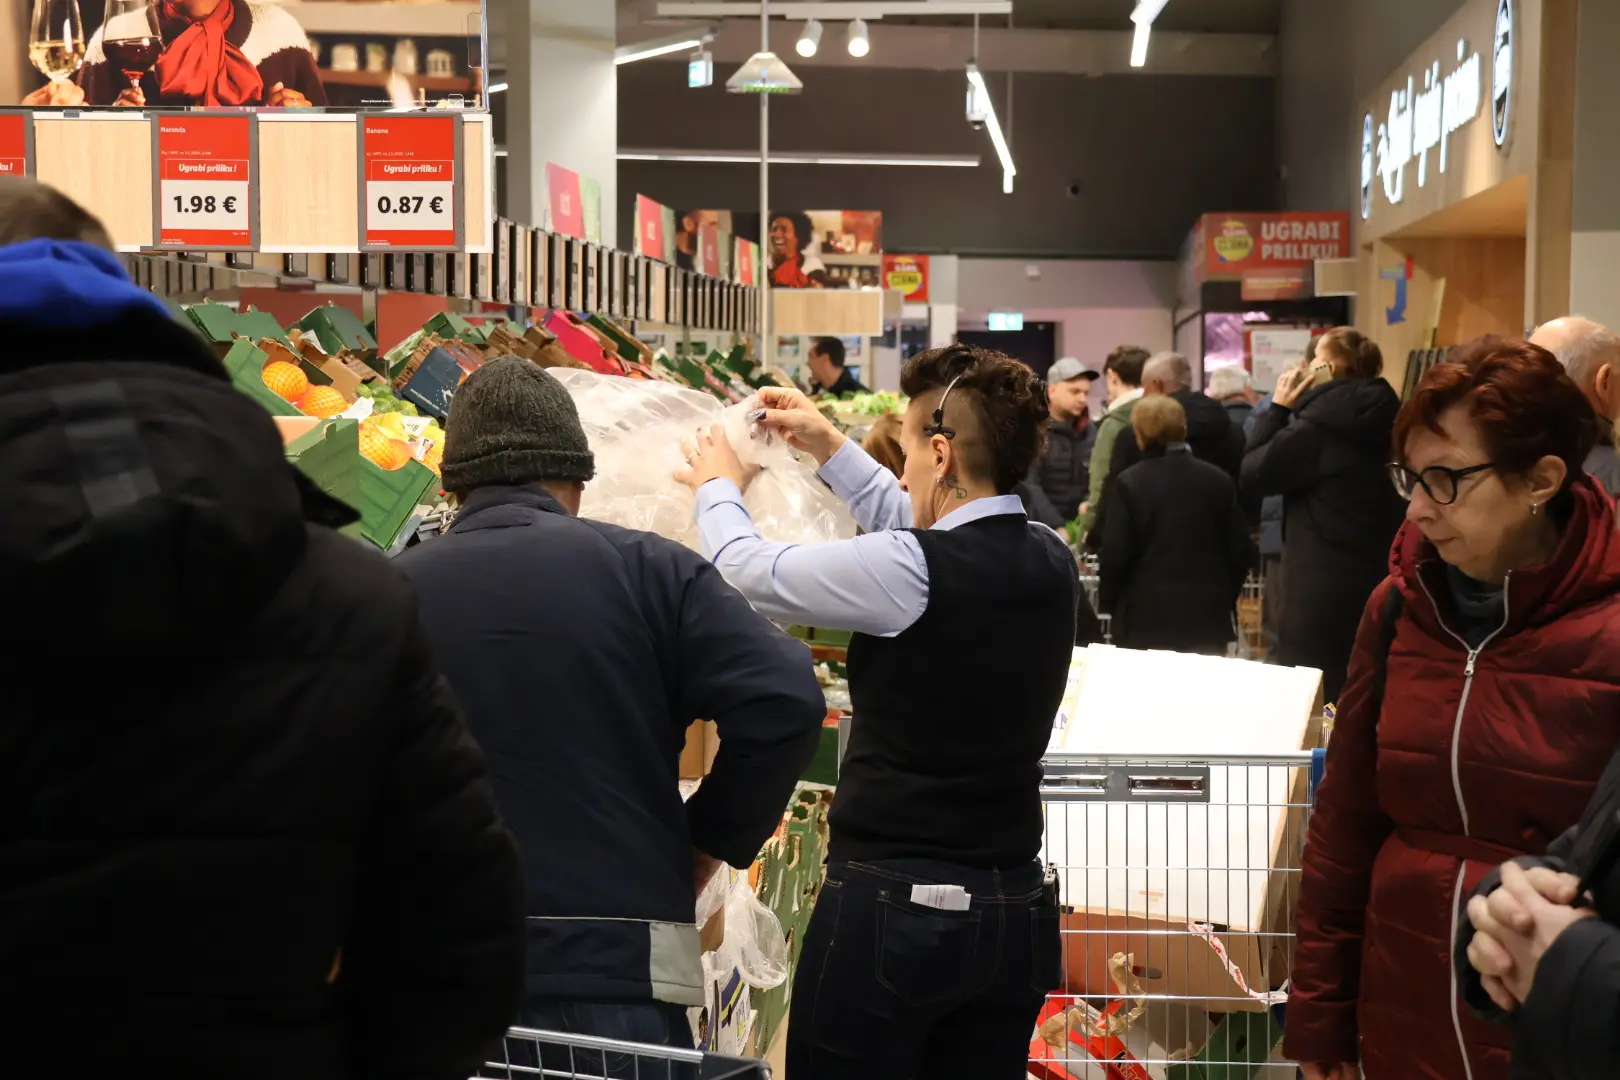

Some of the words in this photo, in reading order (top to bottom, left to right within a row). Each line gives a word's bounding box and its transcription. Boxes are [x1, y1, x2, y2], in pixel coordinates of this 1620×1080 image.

[178, 163, 206, 173] Ugrabi
[206, 163, 233, 173] priliku
[383, 164, 411, 174] Ugrabi
[411, 164, 438, 174] priliku
[173, 195, 217, 214] 1.98
[222, 195, 238, 214] €
[377, 195, 424, 214] 0.87
[429, 195, 444, 214] €
[1261, 221, 1340, 239] UGRABI
[1261, 243, 1339, 260] PRILIKU!
